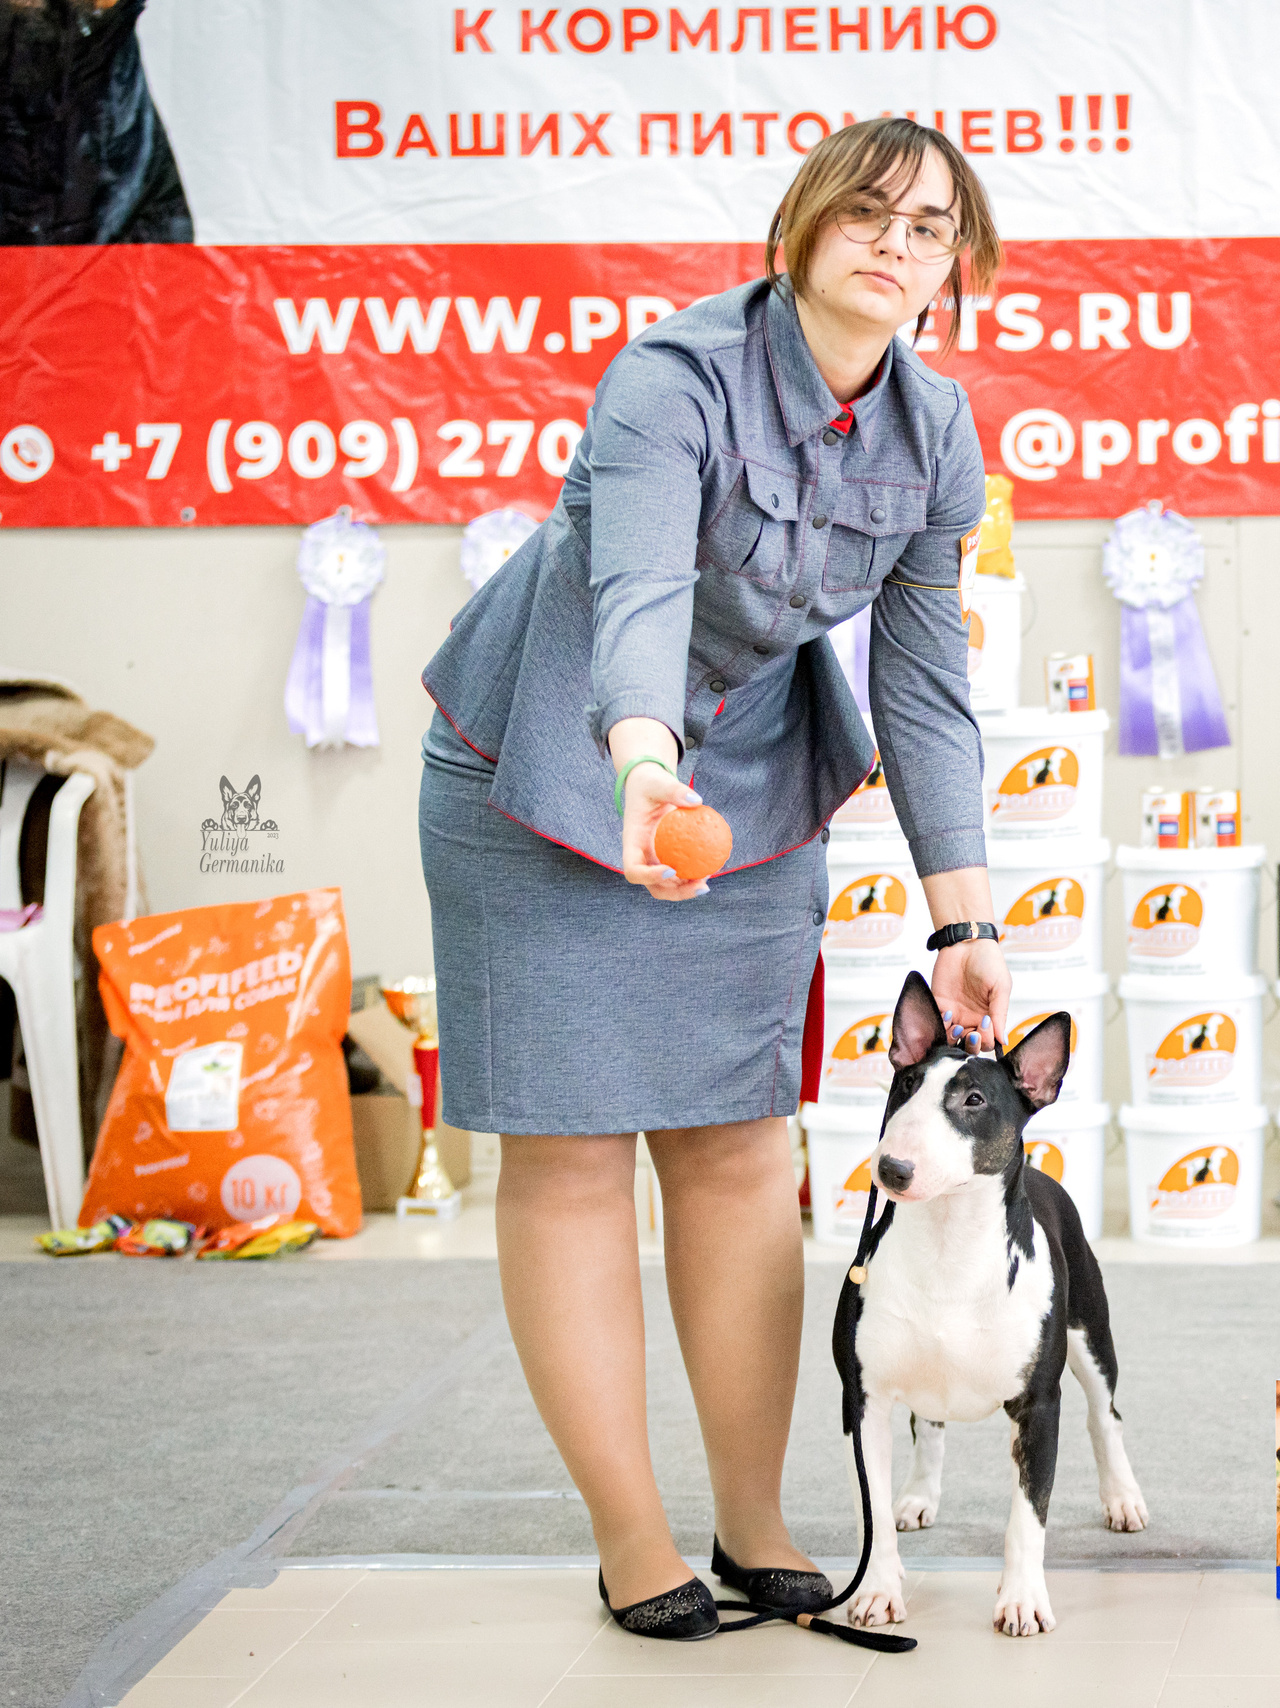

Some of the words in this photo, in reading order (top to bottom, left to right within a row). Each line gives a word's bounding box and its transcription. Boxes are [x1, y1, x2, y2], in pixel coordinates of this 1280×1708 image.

[454, 8, 495, 54] К
[519, 4, 997, 54] КОРМЛЕНИЮ
[639, 94, 1132, 157] ПИТОЕВ!!!
[90, 423, 182, 480] +7
[207, 419, 419, 493] (909)
[231, 1178, 256, 1210] 10
